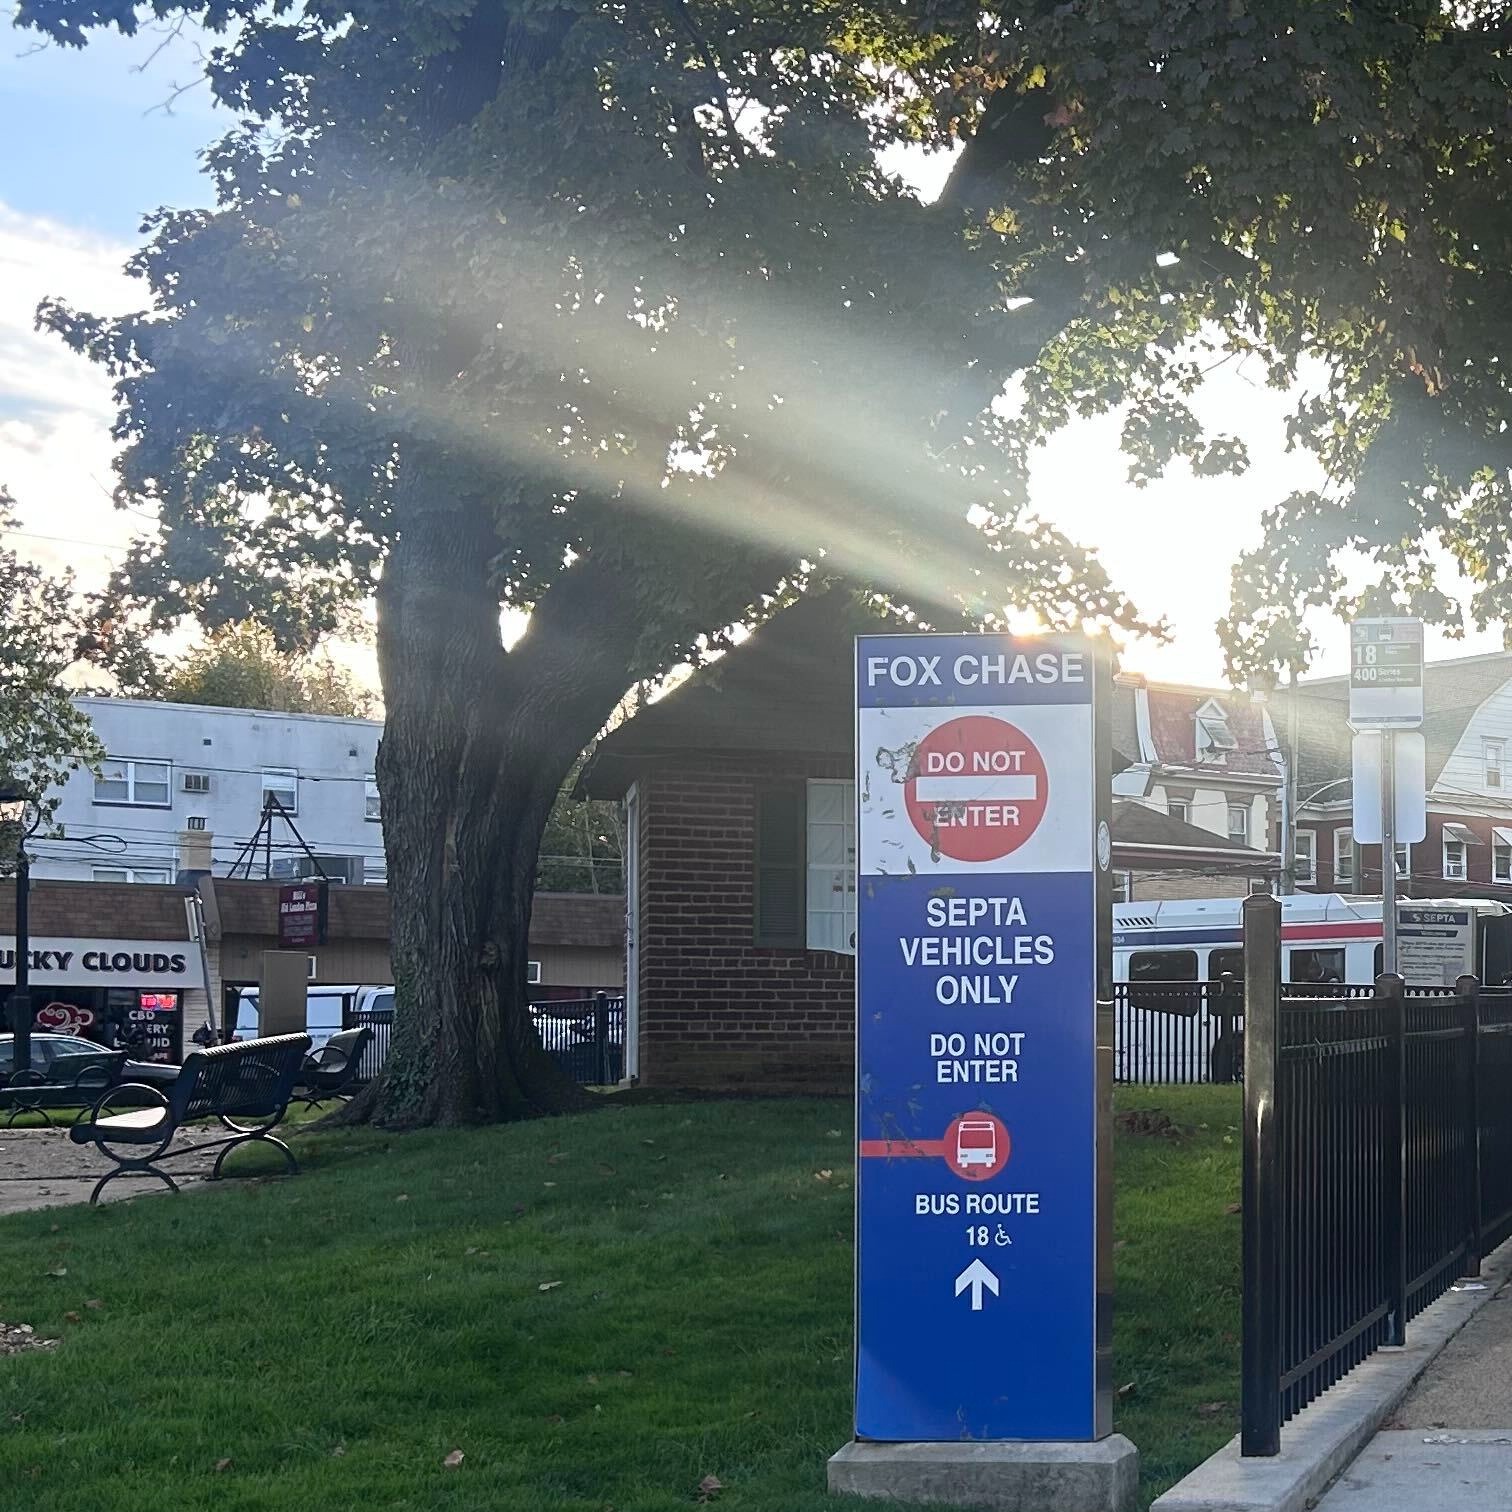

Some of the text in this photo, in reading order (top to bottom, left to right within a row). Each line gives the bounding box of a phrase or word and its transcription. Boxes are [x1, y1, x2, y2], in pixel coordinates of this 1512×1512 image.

[1354, 645, 1377, 665] 18
[867, 653, 1085, 687] FOX CHASE
[1354, 667, 1377, 681] 400
[927, 750, 1026, 773] DO NOT
[933, 805, 1020, 827] ENTER
[926, 896, 1027, 928] SEPTA
[1423, 913, 1456, 923] SEPTA
[0, 950, 187, 973] UKY CLOUDS
[900, 934, 1055, 967] VEHICLES
[935, 974, 1020, 1005] ONLY
[128, 1010, 156, 1021] CBD
[930, 1032, 1025, 1057] DO NOT
[937, 1060, 1019, 1083] ENTER
[915, 1193, 1040, 1215] BUS ROUTE
[965, 1225, 989, 1246] 18
